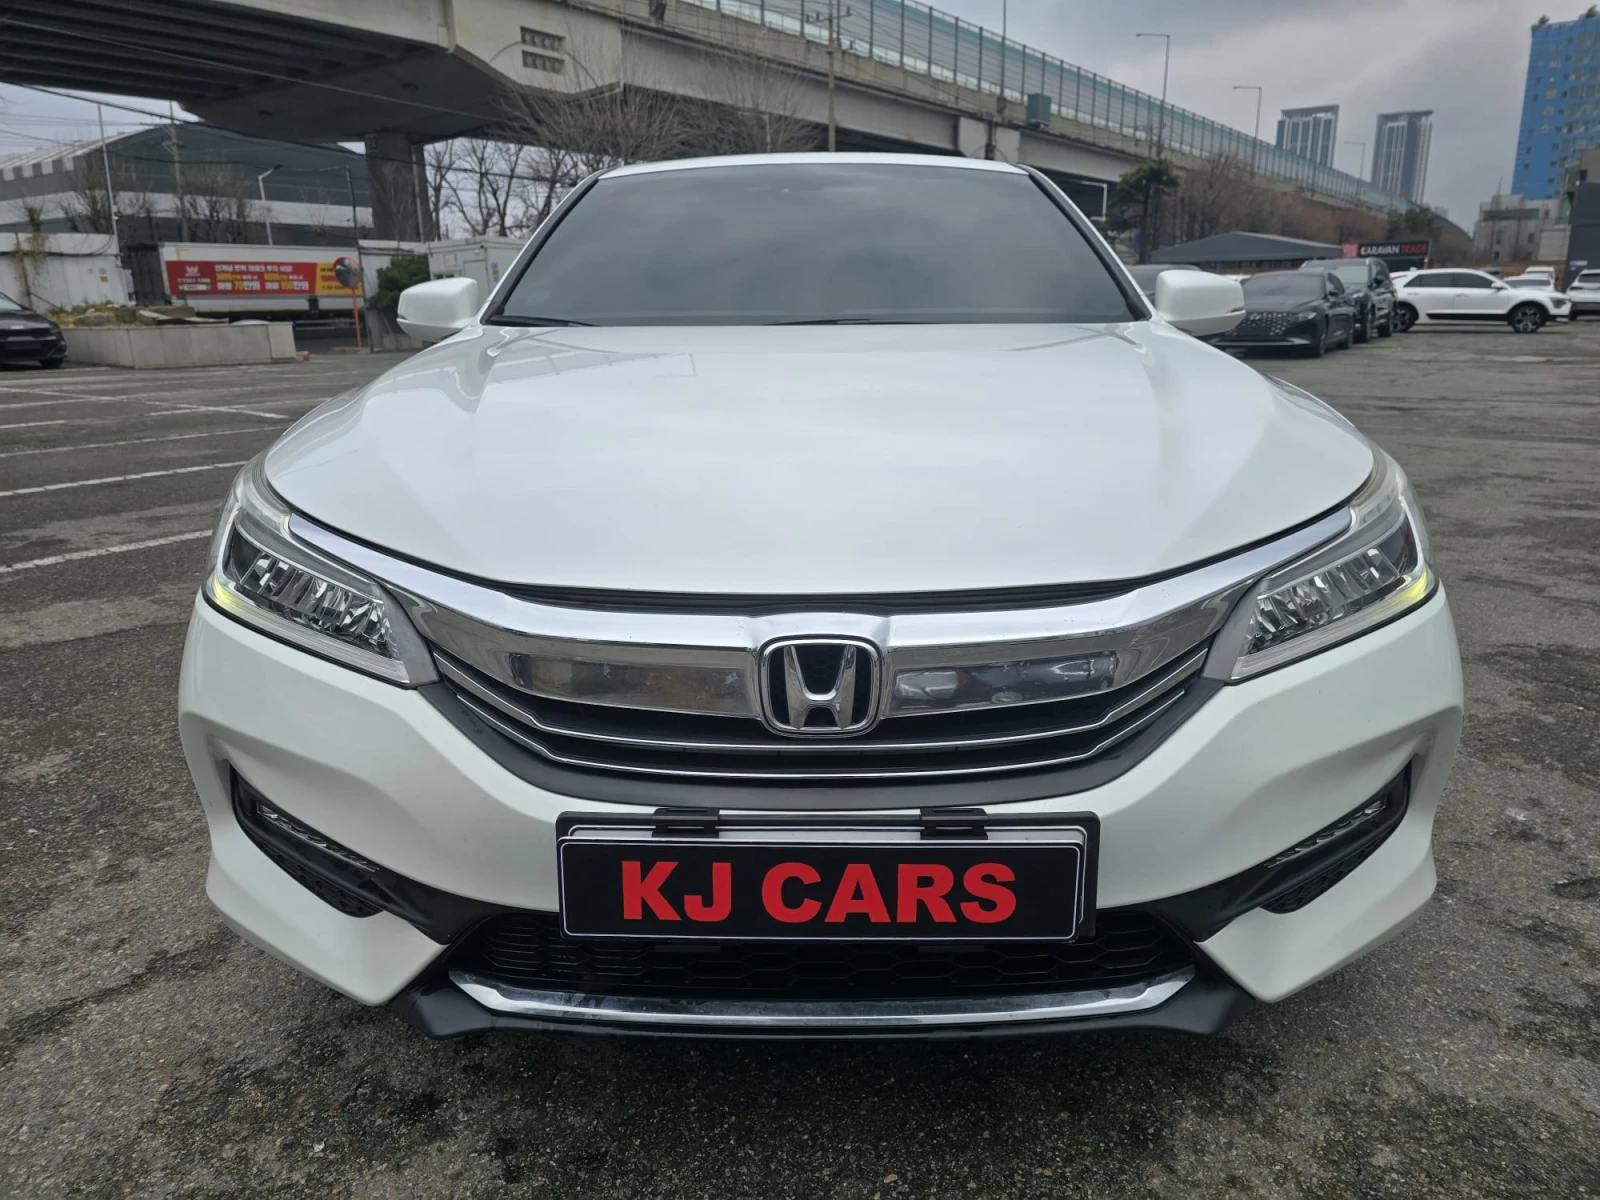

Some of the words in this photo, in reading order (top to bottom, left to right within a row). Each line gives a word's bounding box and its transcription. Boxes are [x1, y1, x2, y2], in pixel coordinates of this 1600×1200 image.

[1360, 245, 1400, 256] CARAVAN
[621, 860, 733, 924] KJ
[761, 862, 1017, 924] CARS
